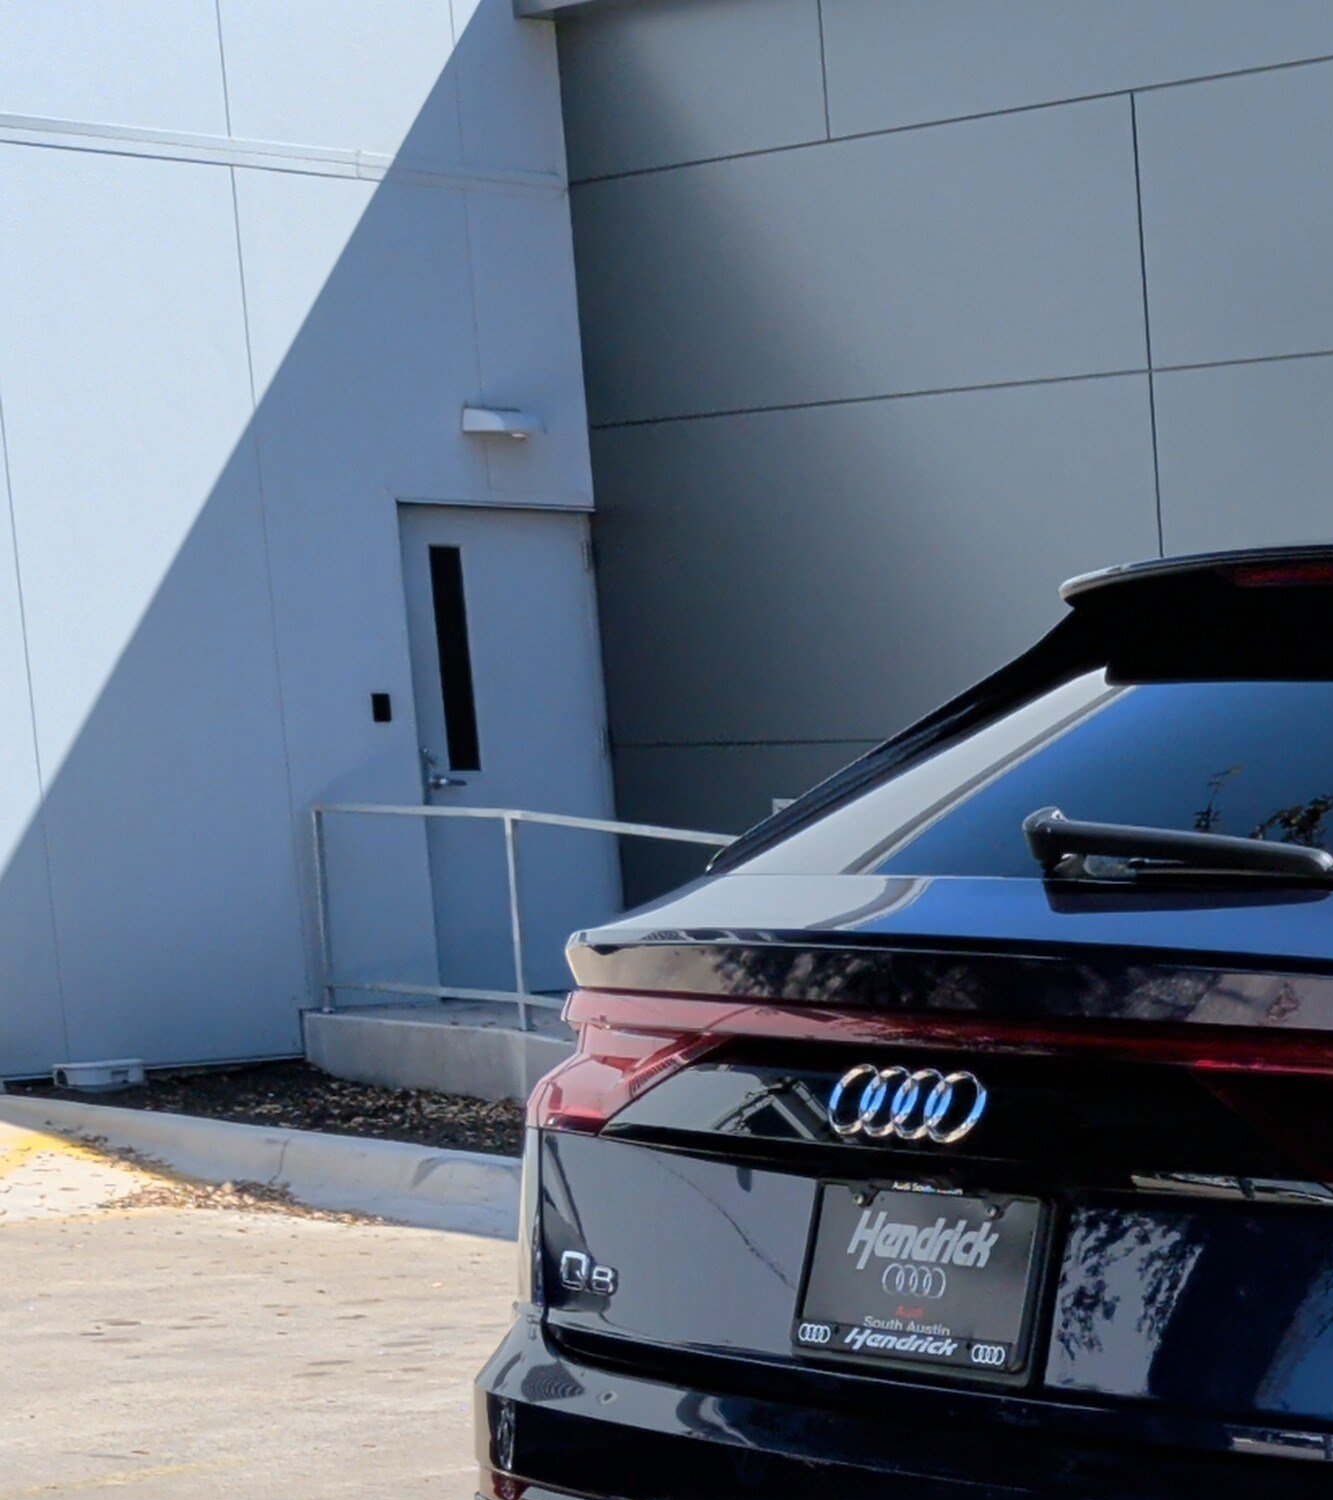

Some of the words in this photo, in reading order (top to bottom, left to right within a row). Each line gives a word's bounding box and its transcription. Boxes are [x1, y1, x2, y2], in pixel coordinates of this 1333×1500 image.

[847, 1210, 999, 1269] Hendrick
[561, 1251, 615, 1295] Q8
[844, 1327, 958, 1356] Hendrick
[863, 1315, 903, 1332] South
[906, 1320, 951, 1337] Austin
